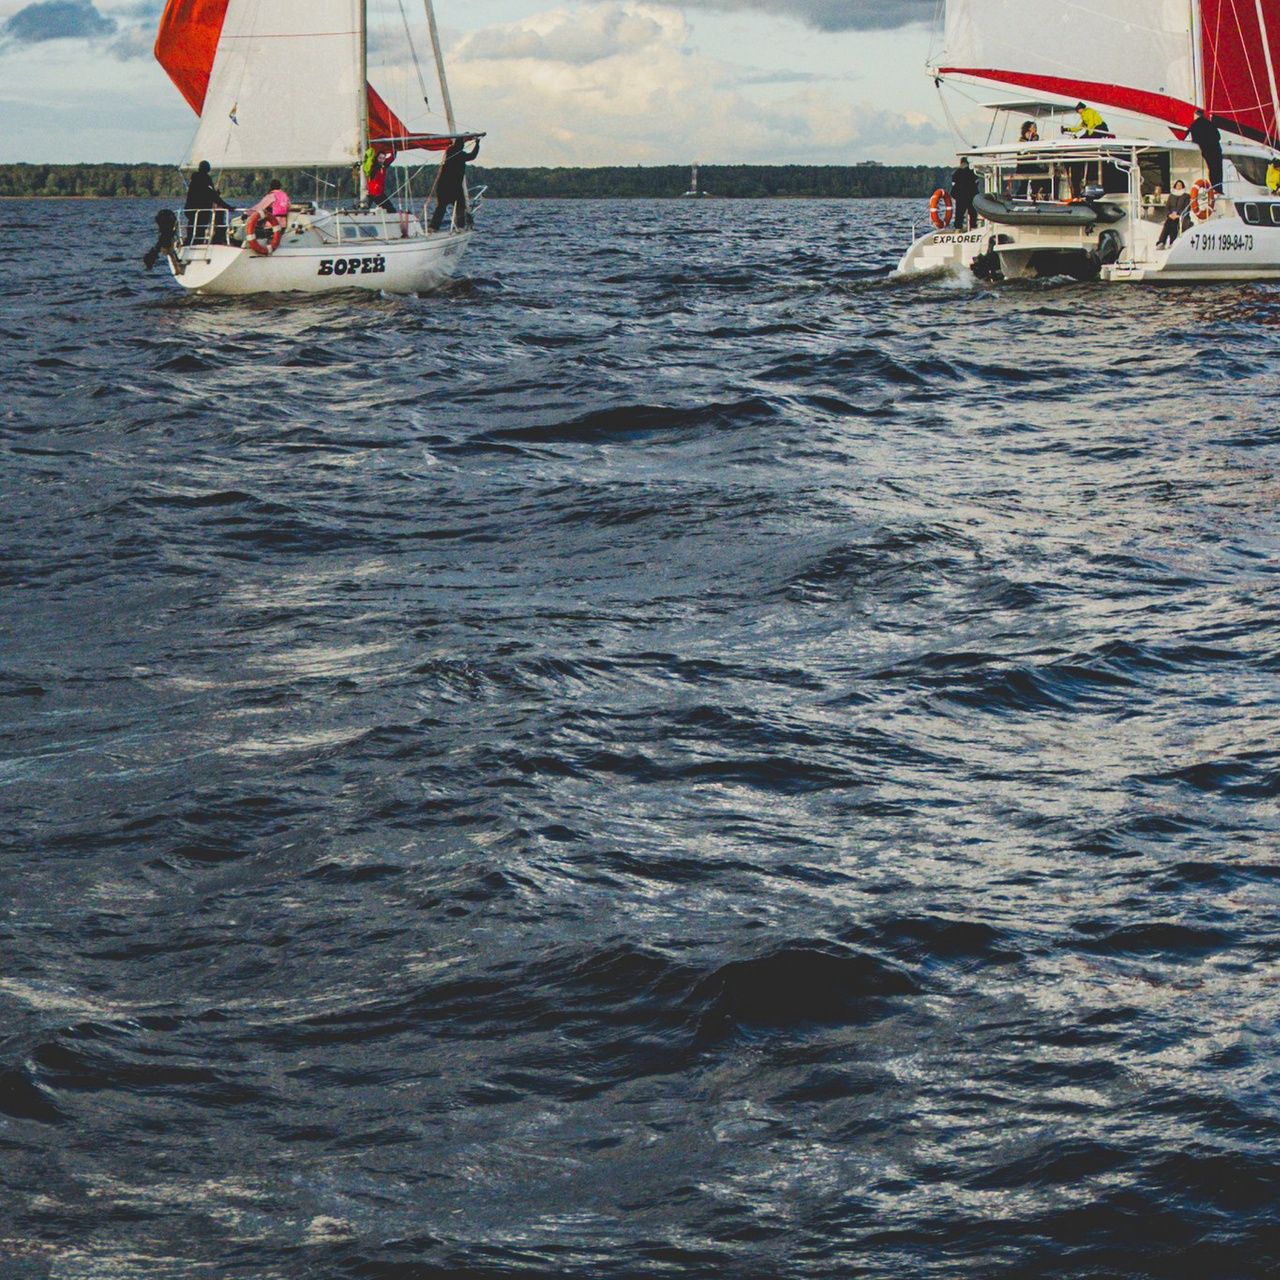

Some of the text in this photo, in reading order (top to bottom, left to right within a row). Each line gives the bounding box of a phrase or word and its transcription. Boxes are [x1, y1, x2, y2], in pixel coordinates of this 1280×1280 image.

[1190, 234, 1254, 251] +7 911 199-84-73
[317, 254, 386, 276] БОРЕЙ
